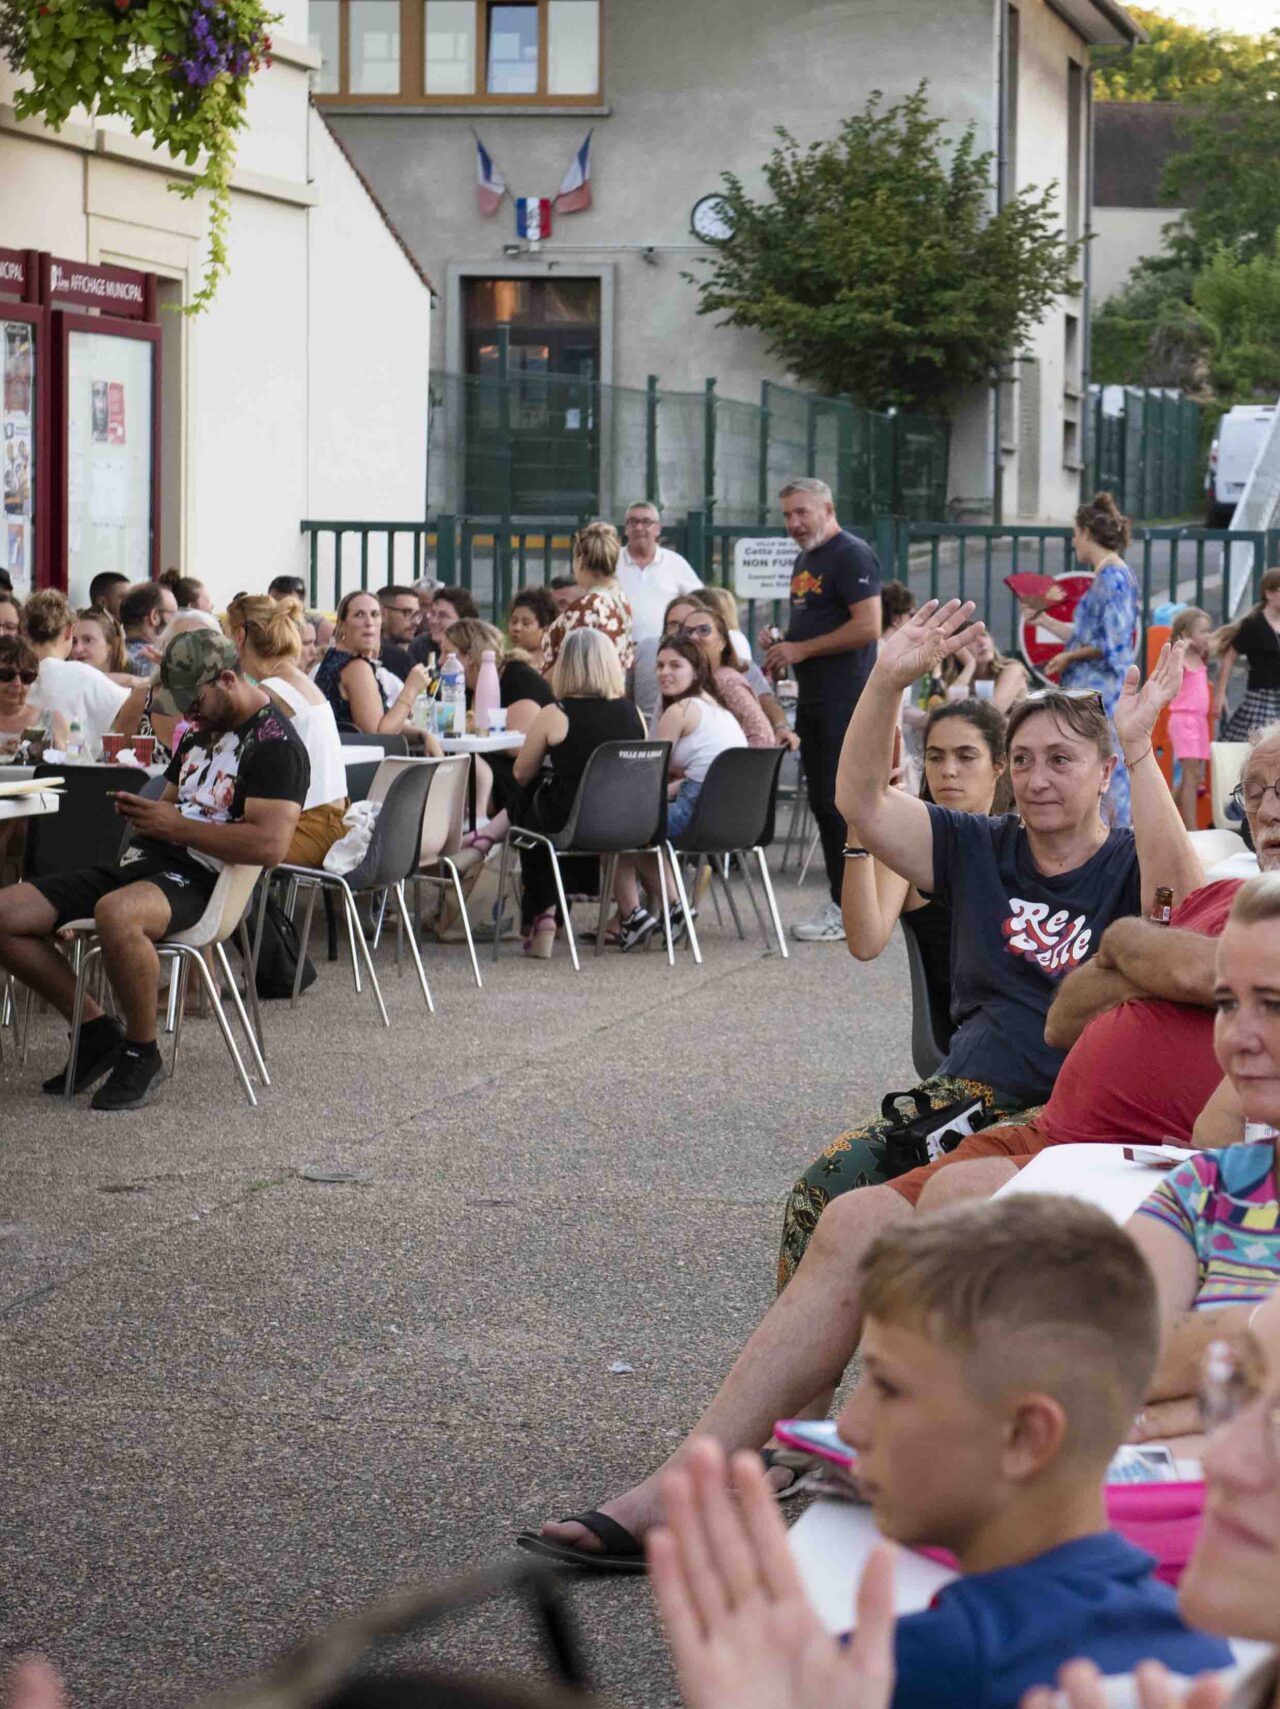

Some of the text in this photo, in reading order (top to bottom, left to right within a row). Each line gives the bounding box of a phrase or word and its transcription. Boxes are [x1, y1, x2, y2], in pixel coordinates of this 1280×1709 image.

[71, 273, 106, 296] AFFICHAGE
[106, 280, 143, 302] MUNICIPAL
[744, 547, 772, 555] Cette
[743, 559, 768, 567] NON
